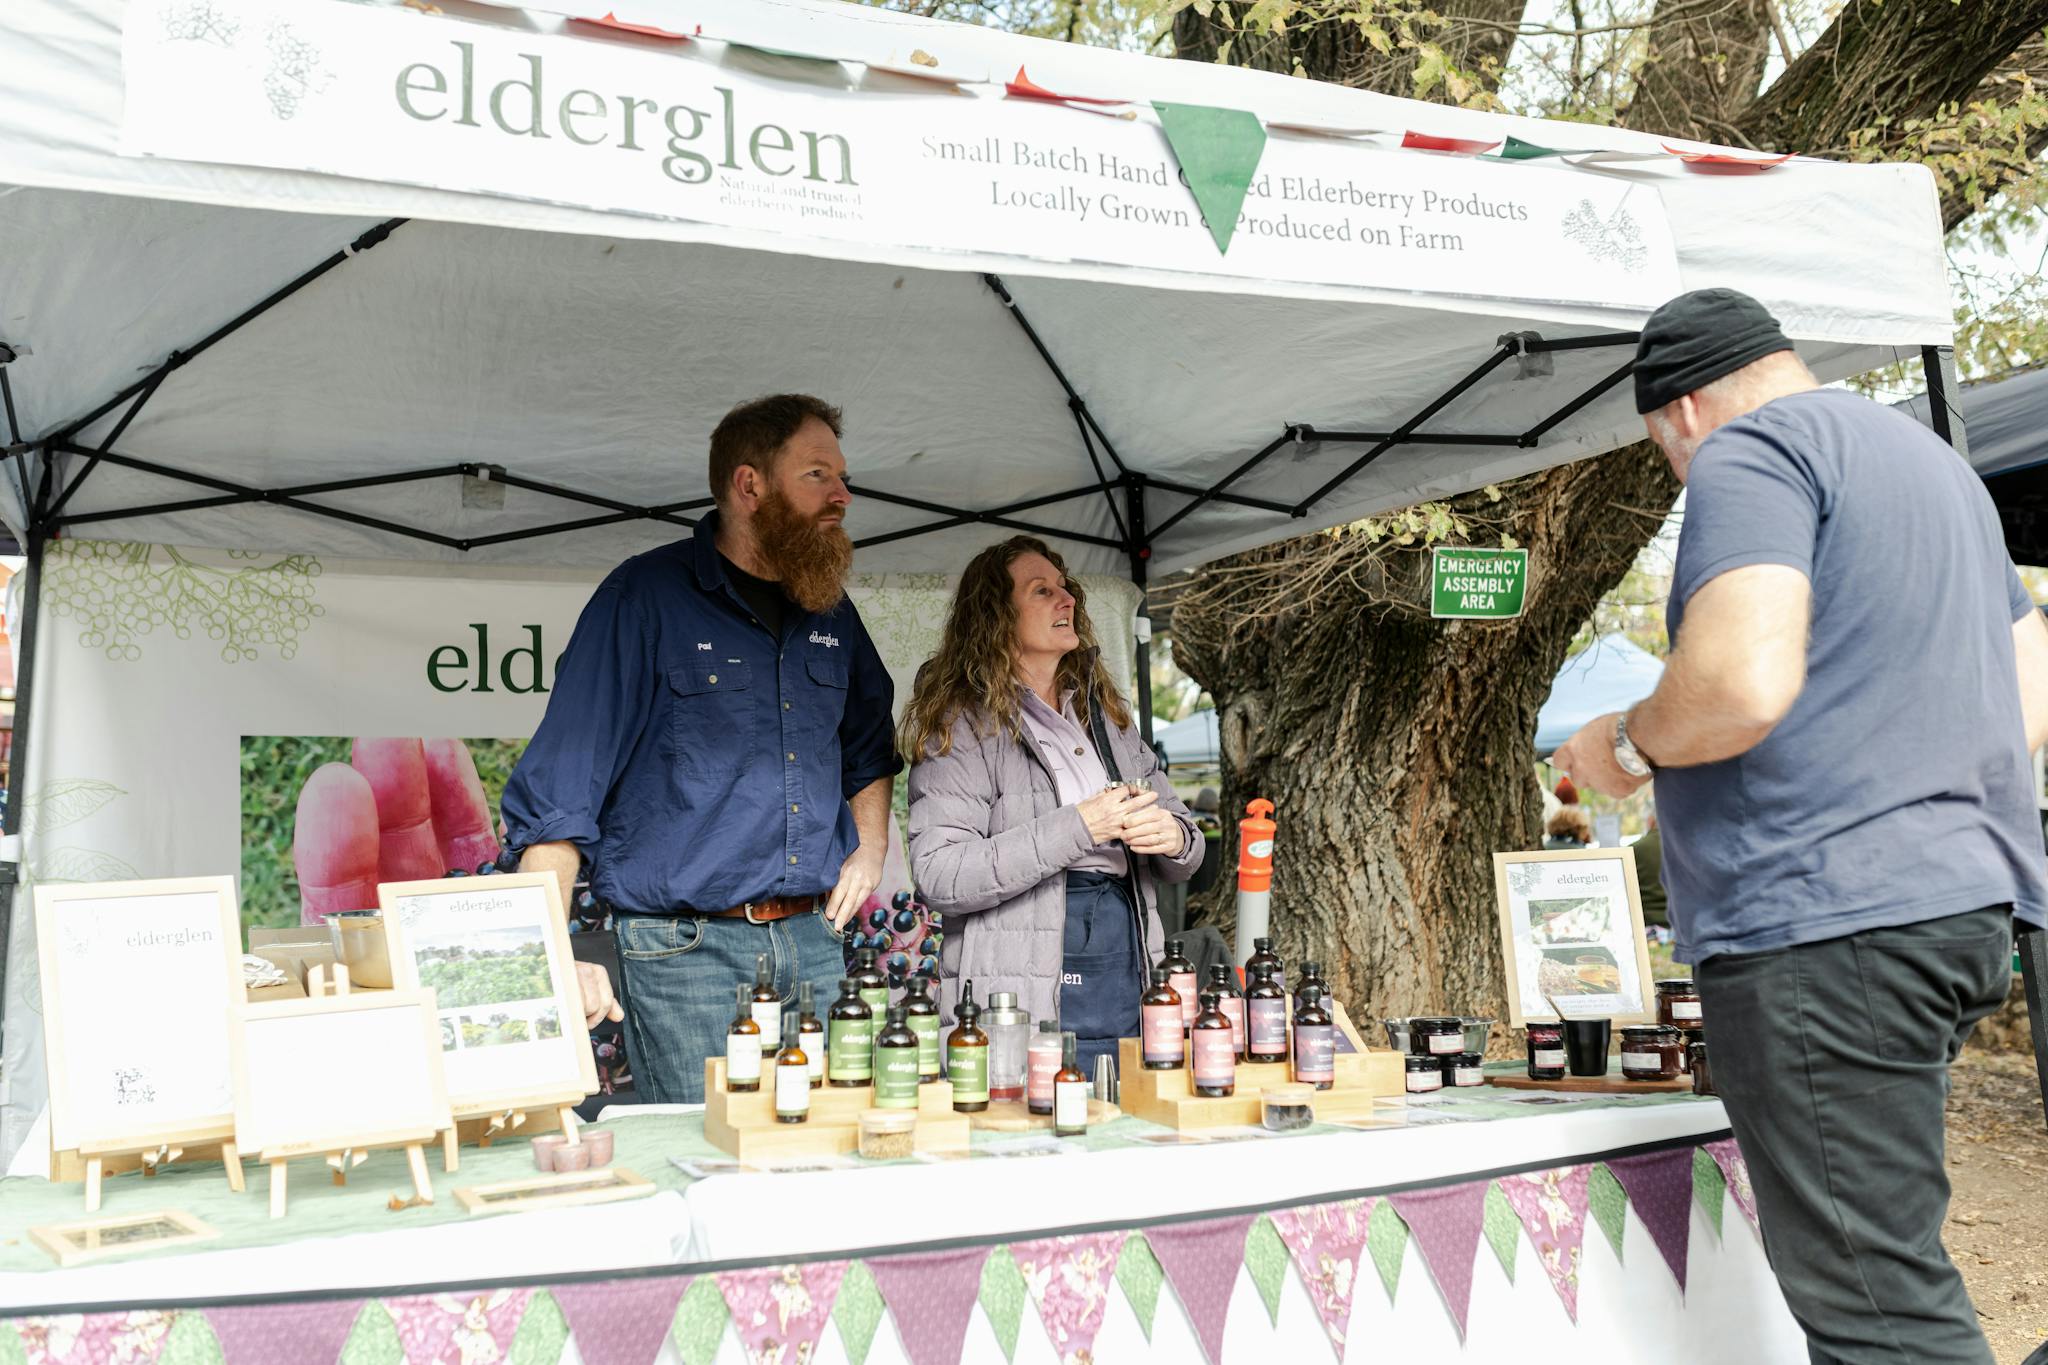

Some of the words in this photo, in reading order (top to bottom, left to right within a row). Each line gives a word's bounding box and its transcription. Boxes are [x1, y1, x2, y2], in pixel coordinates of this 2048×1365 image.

[394, 40, 860, 185] elderglen
[921, 135, 1001, 164] Small
[1013, 141, 1089, 174] Batch
[1098, 152, 1169, 187] Hand
[1280, 177, 1414, 218] Elderberry
[1422, 190, 1529, 222] Products
[991, 181, 1092, 222] Locally
[1099, 193, 1189, 228] Grown
[1359, 226, 1392, 247] on
[1399, 224, 1465, 251] Farm
[1439, 558, 1521, 575] EMERGENCY
[1443, 577, 1515, 593] ASSEMBLY
[1460, 594, 1496, 610] AREA
[426, 623, 564, 694] eld
[1557, 872, 1609, 885] elderglen
[449, 897, 513, 912] elderglen
[126, 927, 213, 948] elderglen
